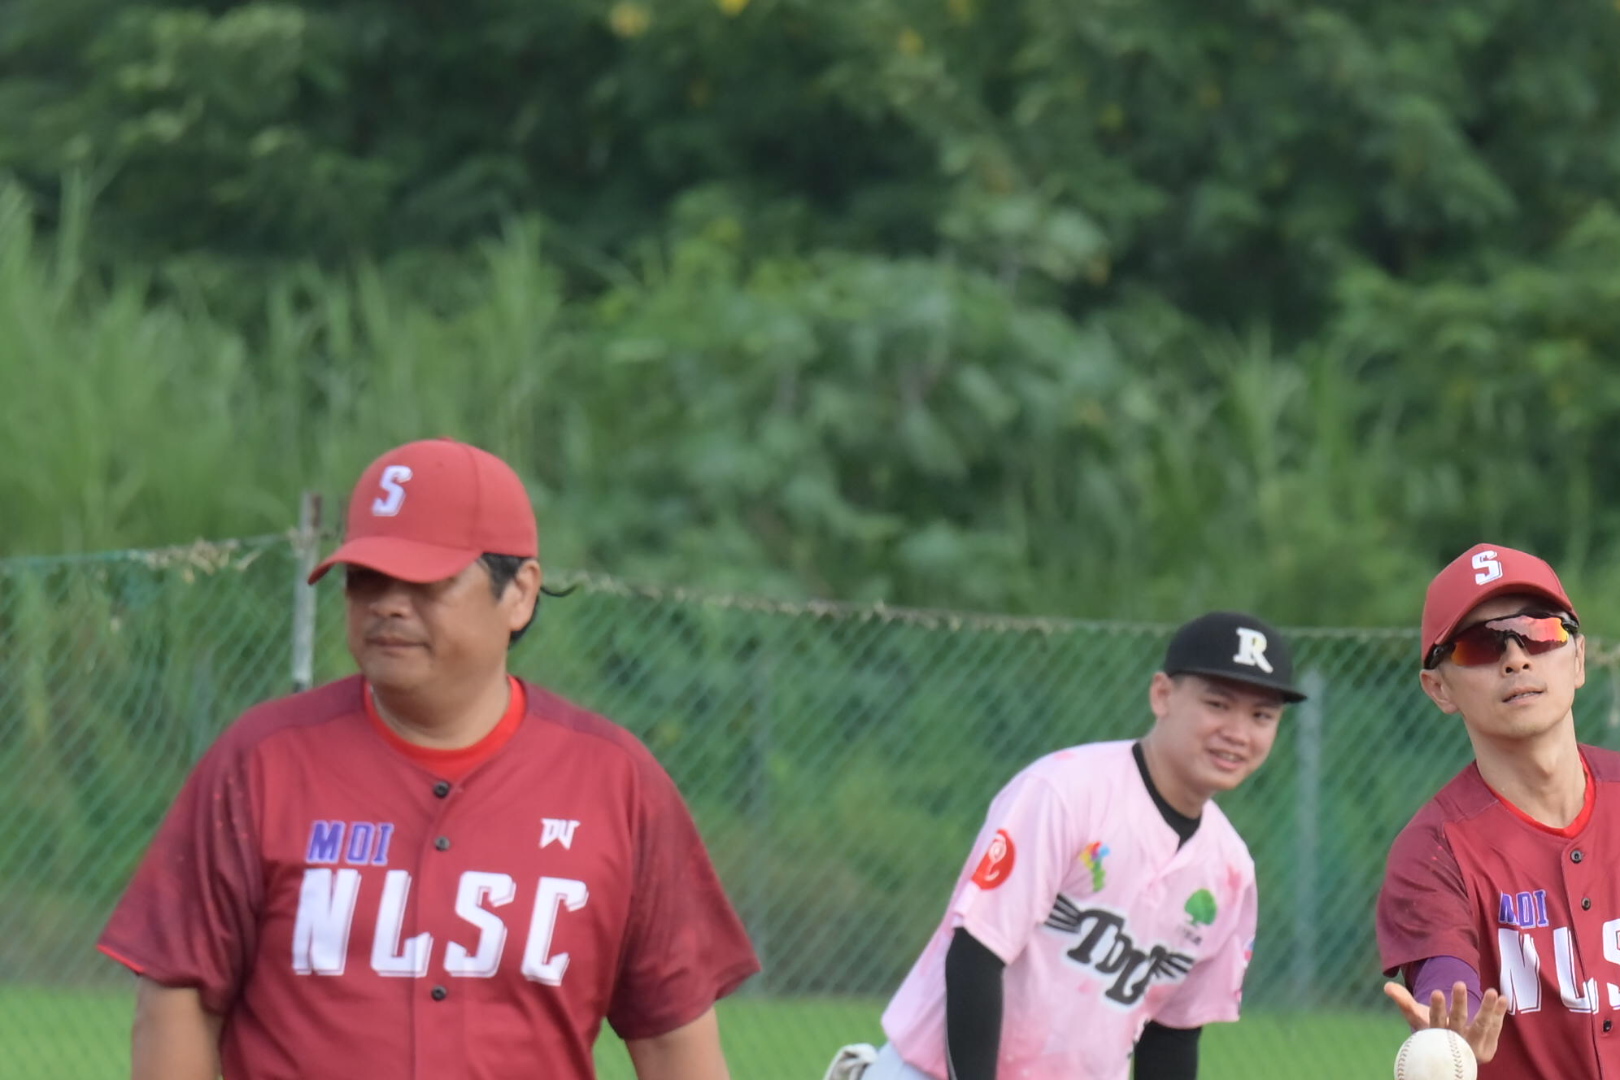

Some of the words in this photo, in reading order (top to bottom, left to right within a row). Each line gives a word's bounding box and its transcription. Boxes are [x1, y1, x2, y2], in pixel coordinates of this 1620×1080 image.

[372, 465, 413, 516] S
[1471, 550, 1503, 586] S
[1233, 627, 1273, 673] R
[306, 821, 394, 865] MOI
[292, 868, 589, 987] NLSC
